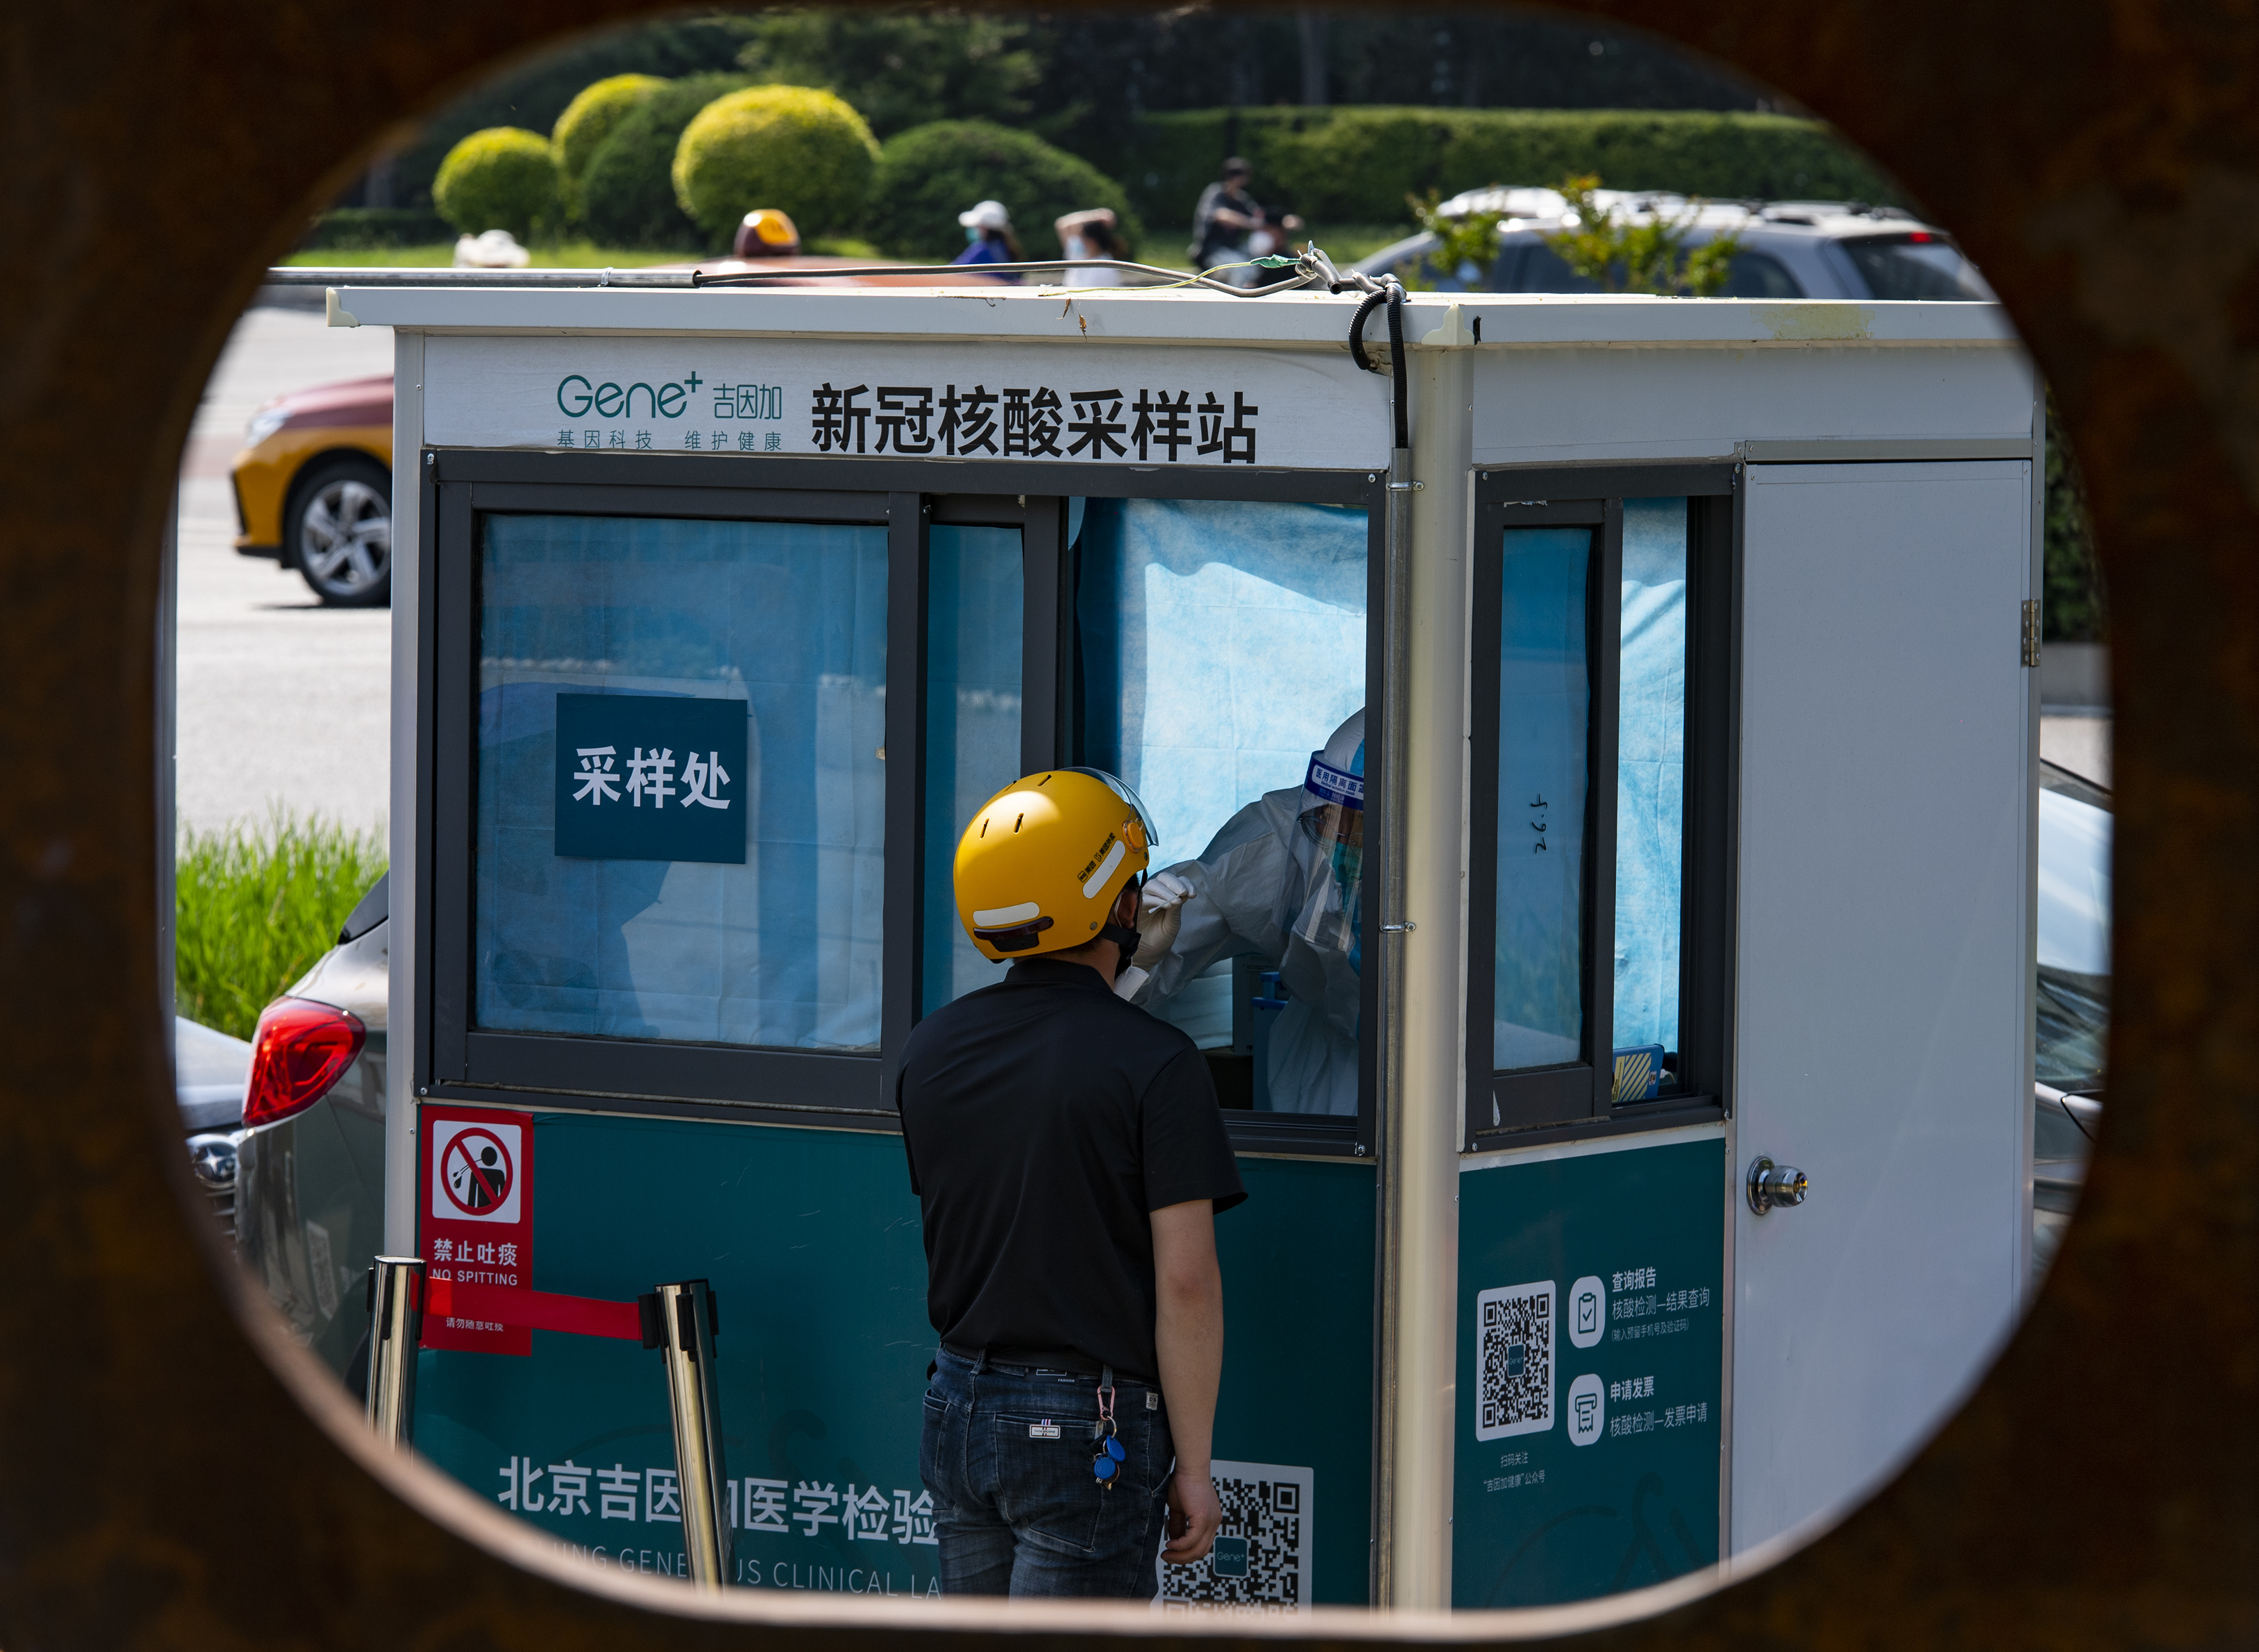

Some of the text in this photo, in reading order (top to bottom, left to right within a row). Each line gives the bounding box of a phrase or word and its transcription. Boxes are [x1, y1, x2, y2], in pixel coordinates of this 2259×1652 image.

[713, 383, 782, 419] 吉因加
[812, 382, 1259, 464] 新冠核酸采样站
[557, 429, 782, 451] 基因科技 维护健康
[572, 745, 731, 809] 采样处
[434, 1238, 518, 1267] 禁止吐痰
[433, 1269, 518, 1286] NO SPITTING
[1612, 1266, 1656, 1292] 查询报告
[1610, 1375, 1655, 1402] 申请发票
[1501, 1451, 1529, 1468] 扫码关注
[498, 1456, 939, 1545] 北京吉因医学检验
[773, 1562, 898, 1597] CLINICAL
